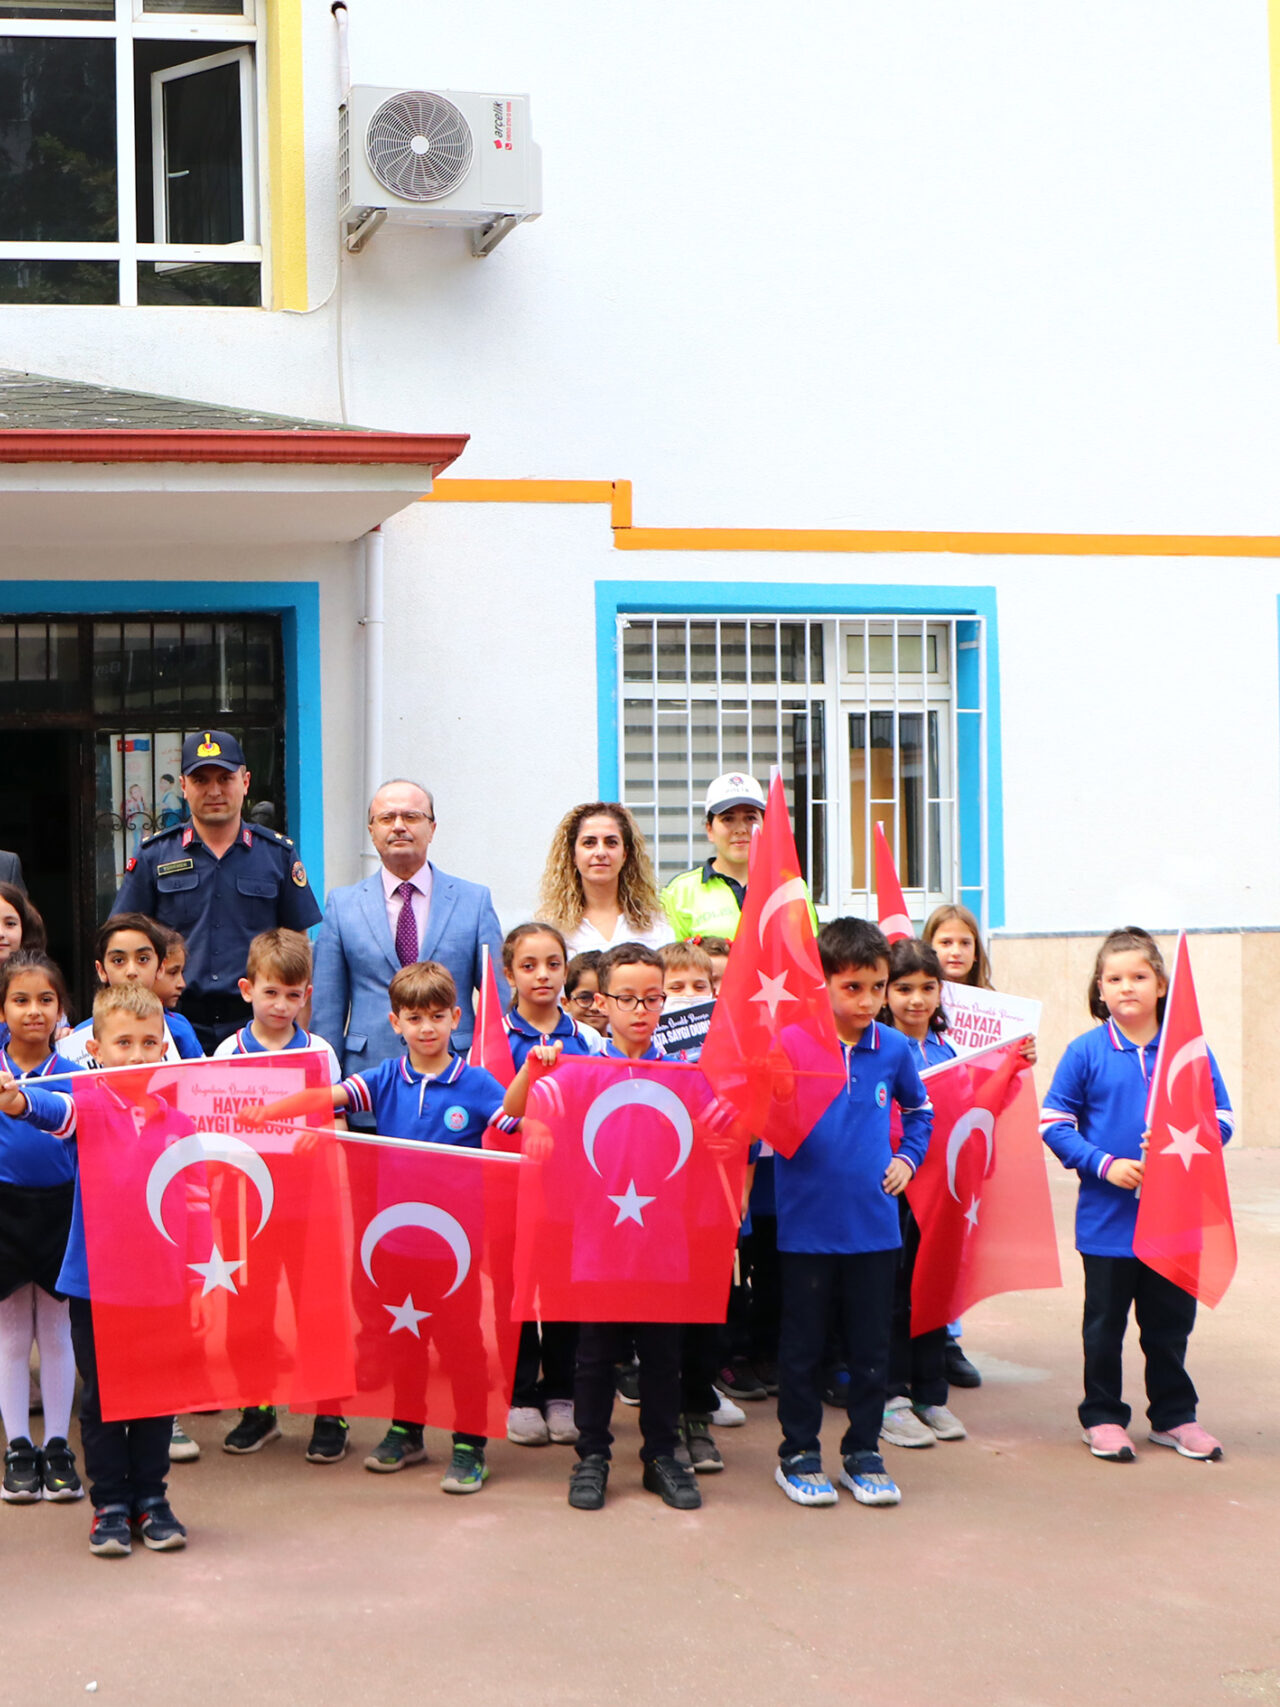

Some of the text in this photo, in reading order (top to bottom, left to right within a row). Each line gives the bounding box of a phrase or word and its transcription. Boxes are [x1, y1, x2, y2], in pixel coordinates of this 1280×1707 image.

[493, 101, 505, 139] arçelik
[666, 1024, 691, 1042] SAYGI
[954, 1011, 1001, 1035] HAYATA
